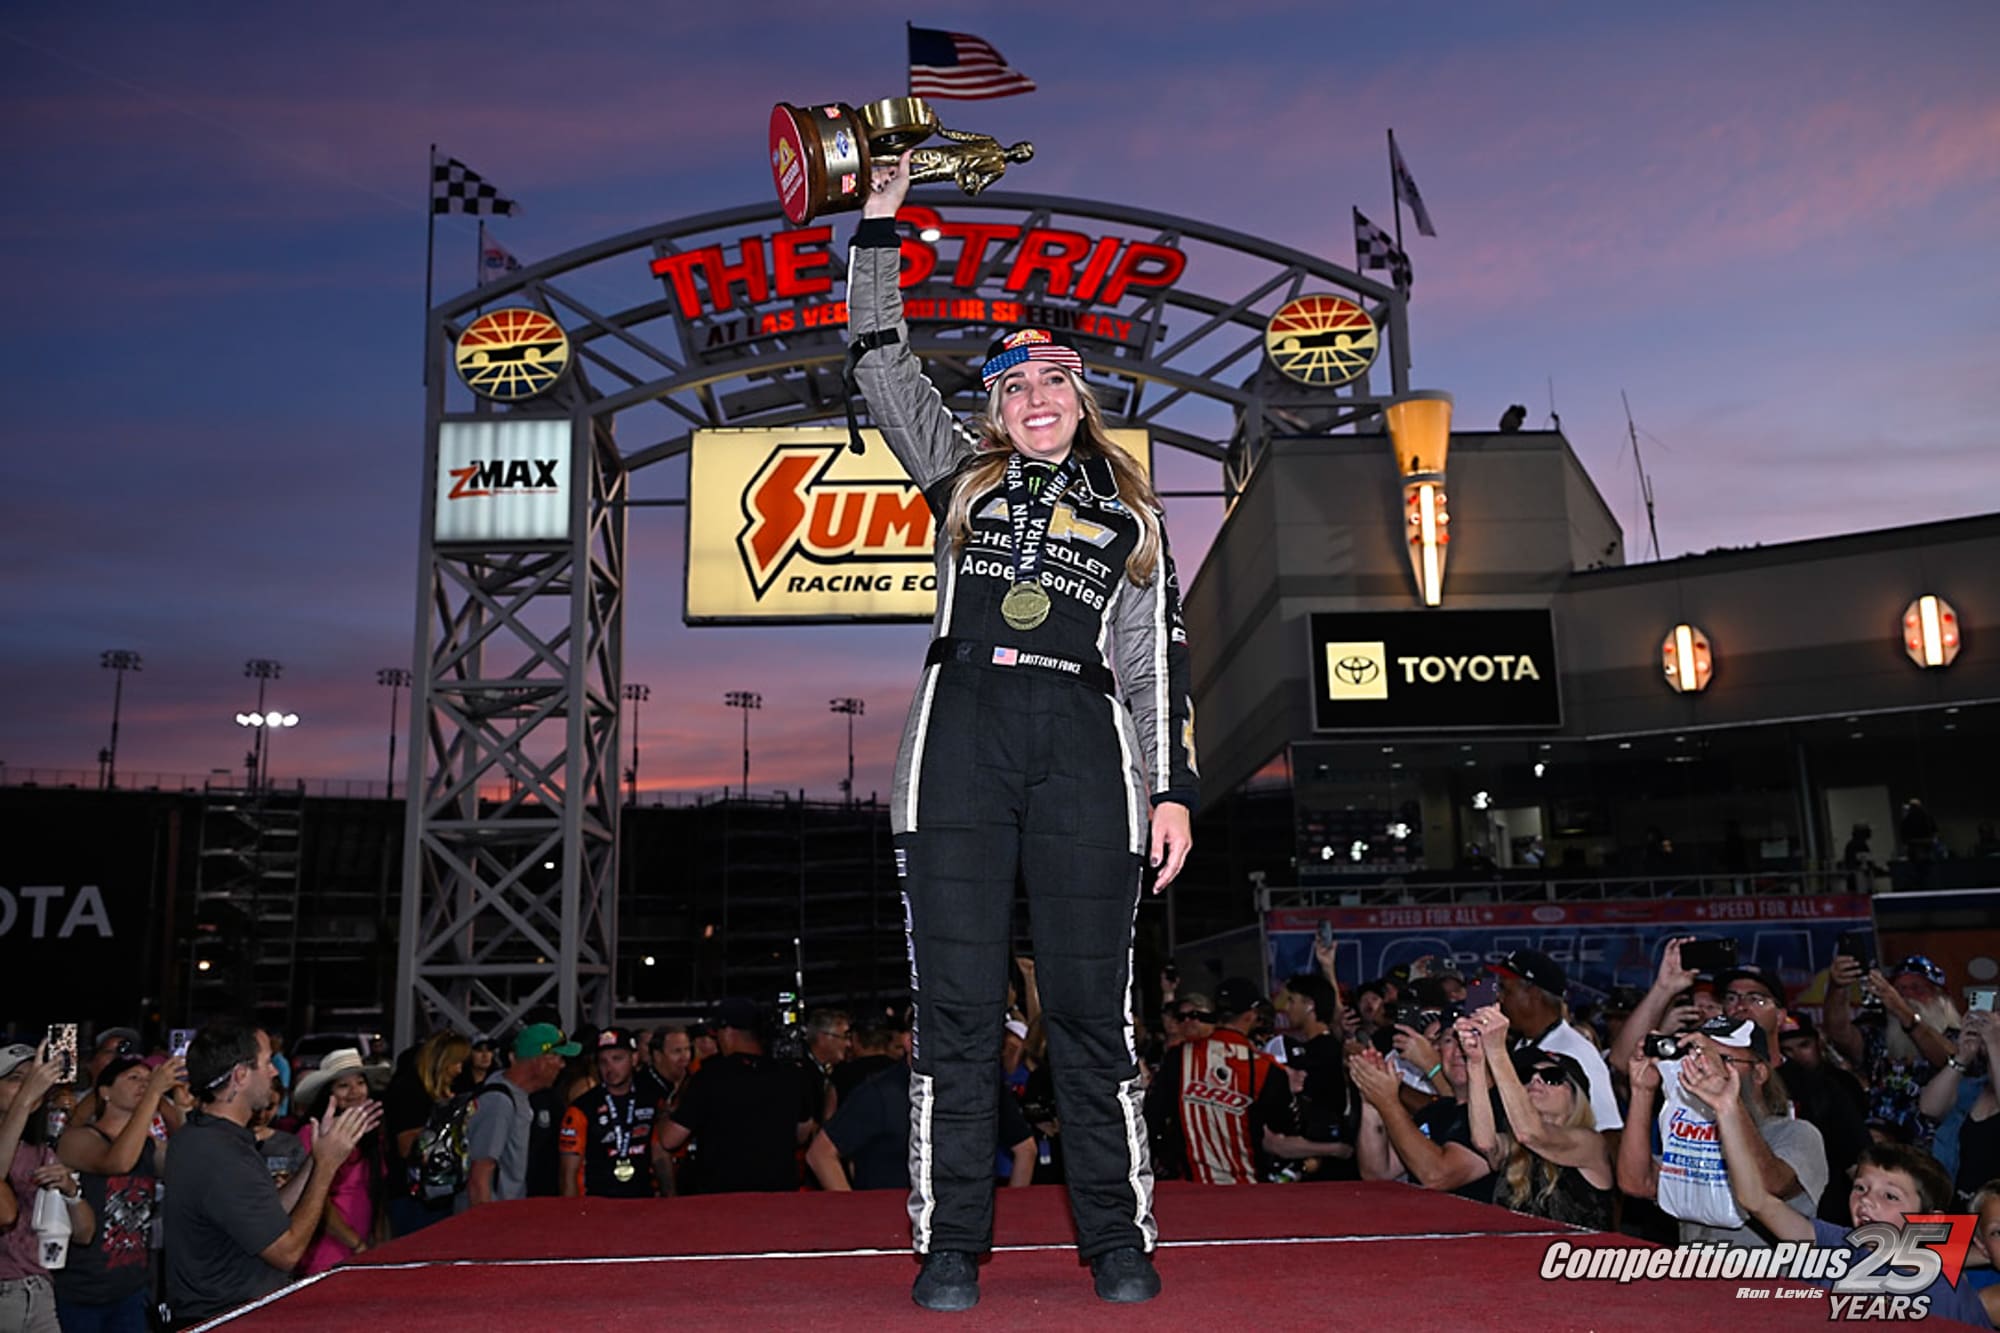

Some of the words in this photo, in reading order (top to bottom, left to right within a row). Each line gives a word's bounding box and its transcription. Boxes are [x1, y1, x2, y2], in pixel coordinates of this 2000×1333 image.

[650, 225, 834, 319] THE
[895, 205, 1187, 308] STRIP
[707, 320, 739, 347] AT
[747, 310, 796, 337] LAS
[991, 300, 1132, 342] SPEEDWAY
[1020, 518, 1047, 570] NHRA
[786, 574, 892, 593] RACING
[1397, 655, 1540, 684] TOYOTA
[1380, 909, 1422, 926] SPEED
[1425, 908, 1453, 924] FOR
[1455, 907, 1480, 923] ALL
[1708, 903, 1755, 919] SPEED
[1758, 902, 1788, 917] FOR
[1792, 902, 1820, 917] ALL
[1185, 1081, 1249, 1108] RAD
